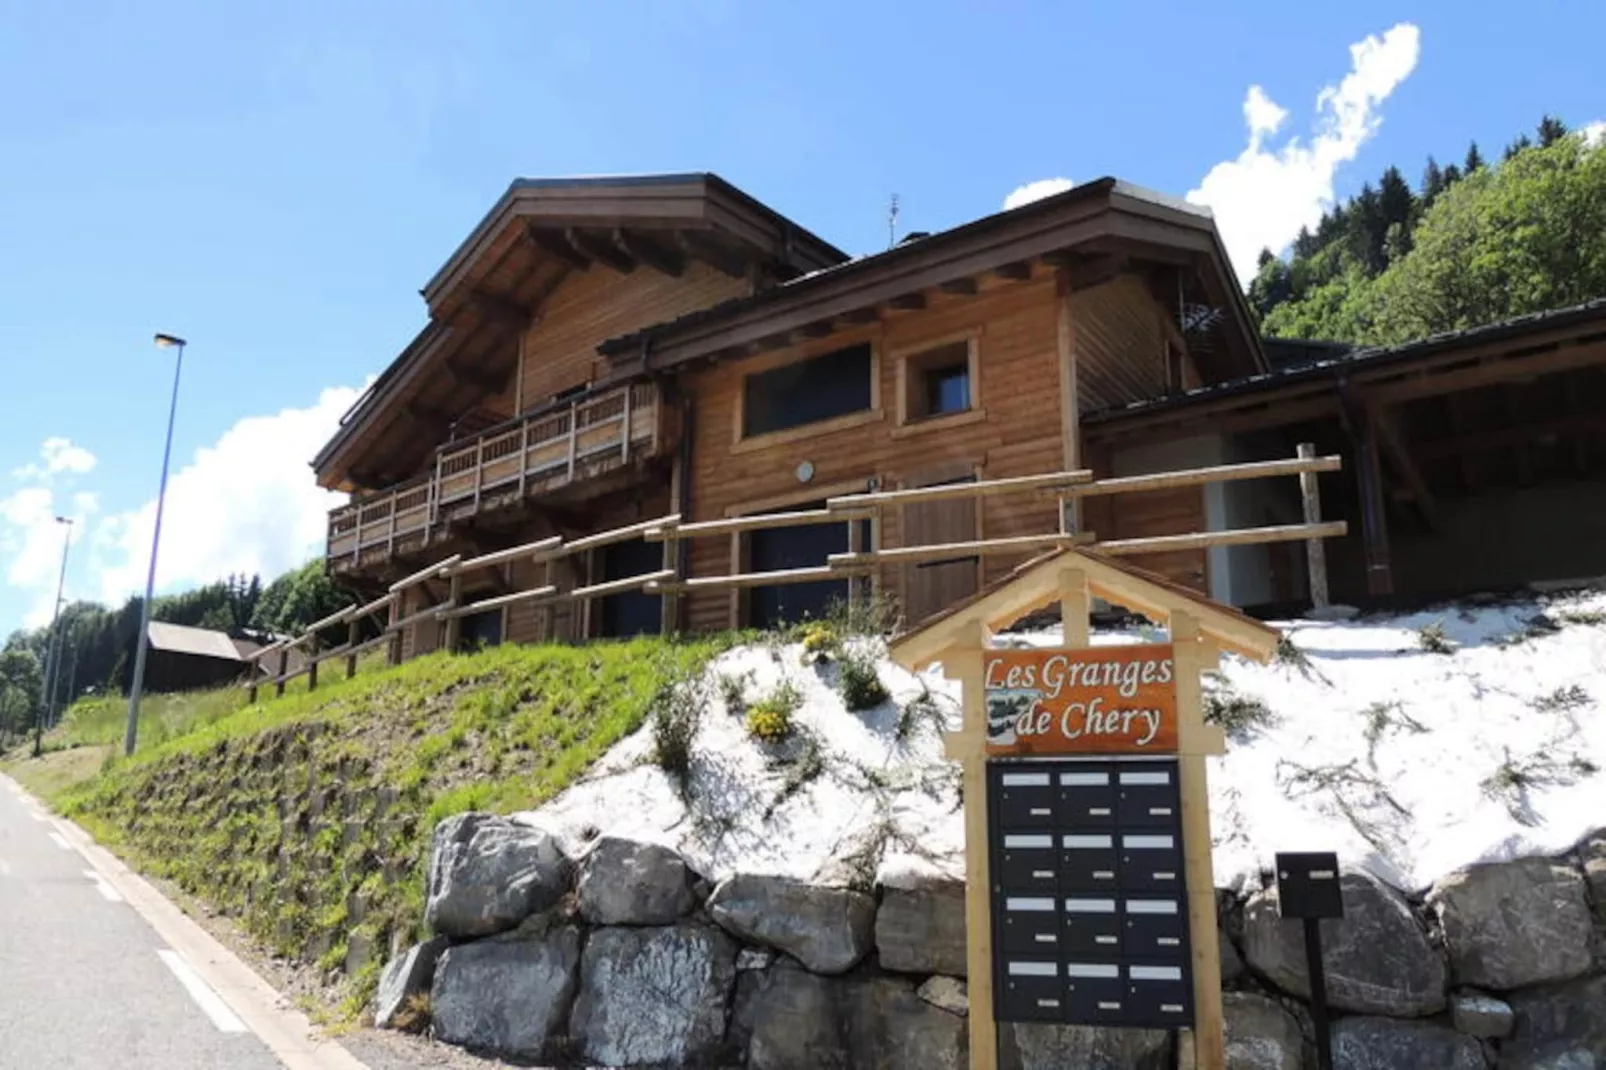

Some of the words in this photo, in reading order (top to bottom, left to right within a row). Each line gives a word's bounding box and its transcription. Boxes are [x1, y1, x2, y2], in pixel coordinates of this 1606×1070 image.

[985, 659, 1036, 689] Les
[1042, 655, 1172, 698] Granges
[1016, 699, 1051, 735] de
[1060, 697, 1160, 745] Chery
